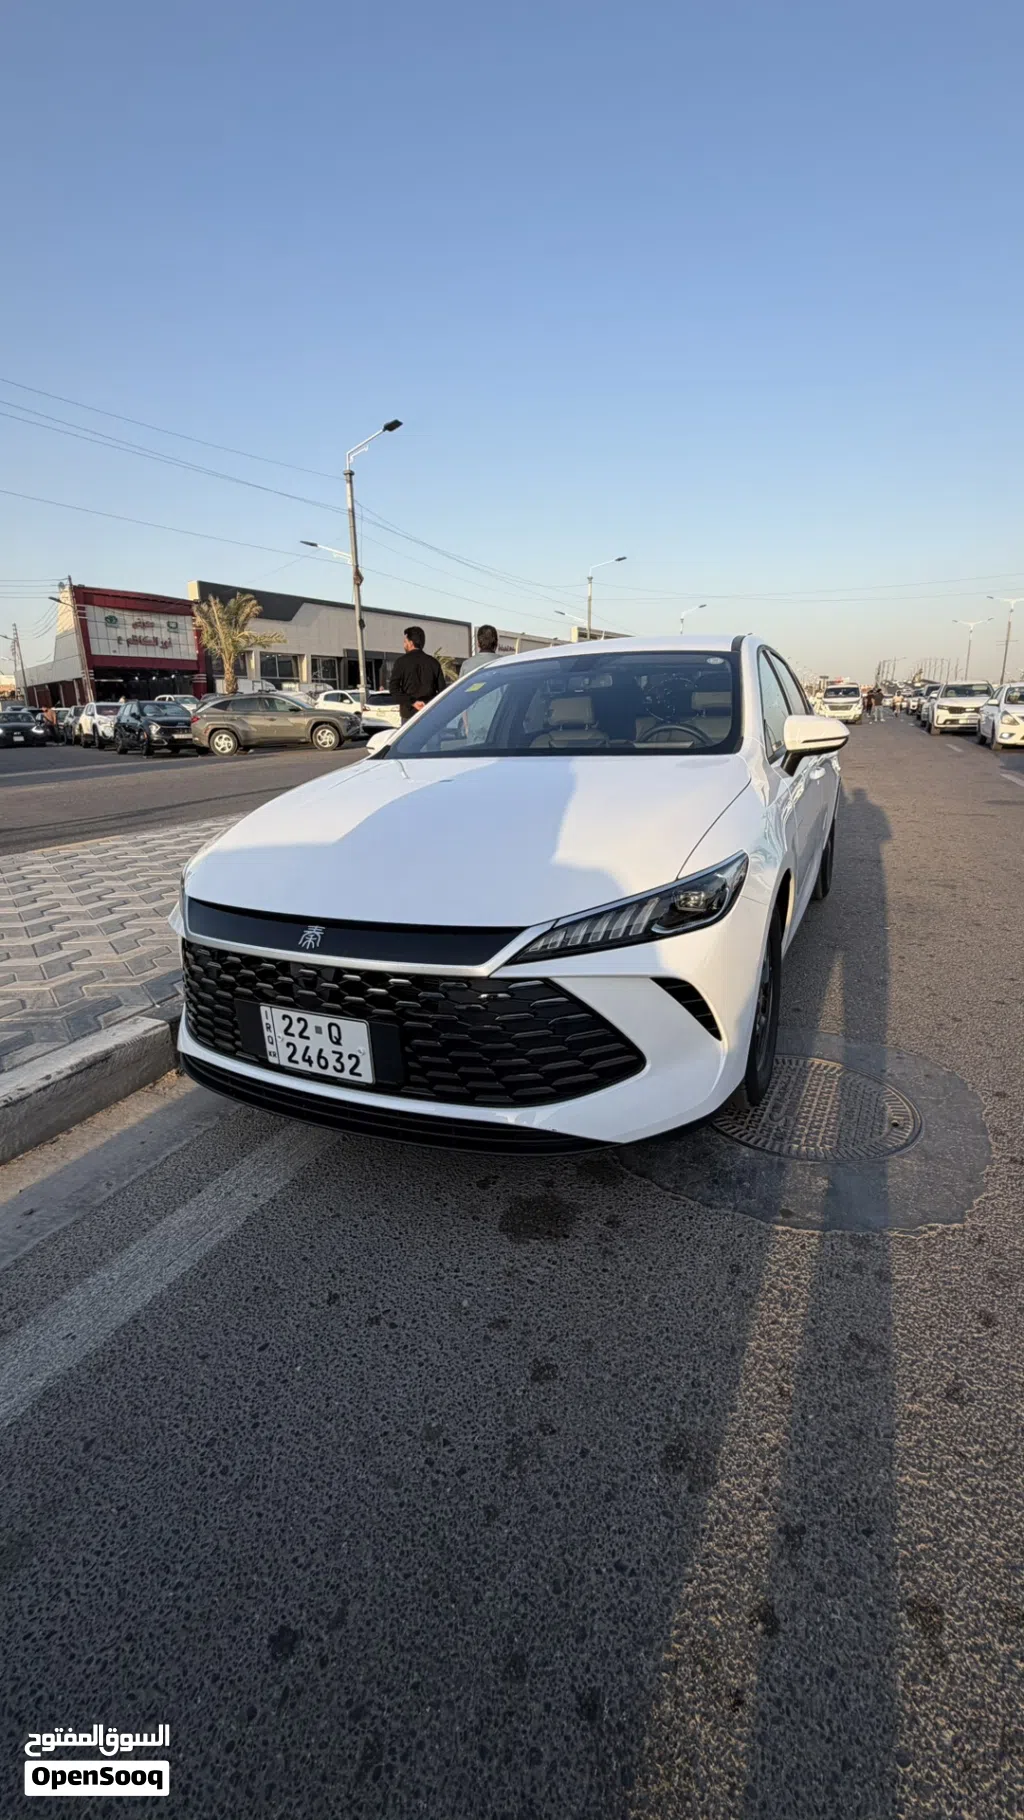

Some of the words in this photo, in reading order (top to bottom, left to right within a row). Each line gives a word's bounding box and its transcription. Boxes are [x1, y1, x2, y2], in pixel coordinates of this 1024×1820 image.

[281, 1014, 311, 1040] 22
[327, 1022, 343, 1046] Q
[286, 1042, 362, 1077] 24632
